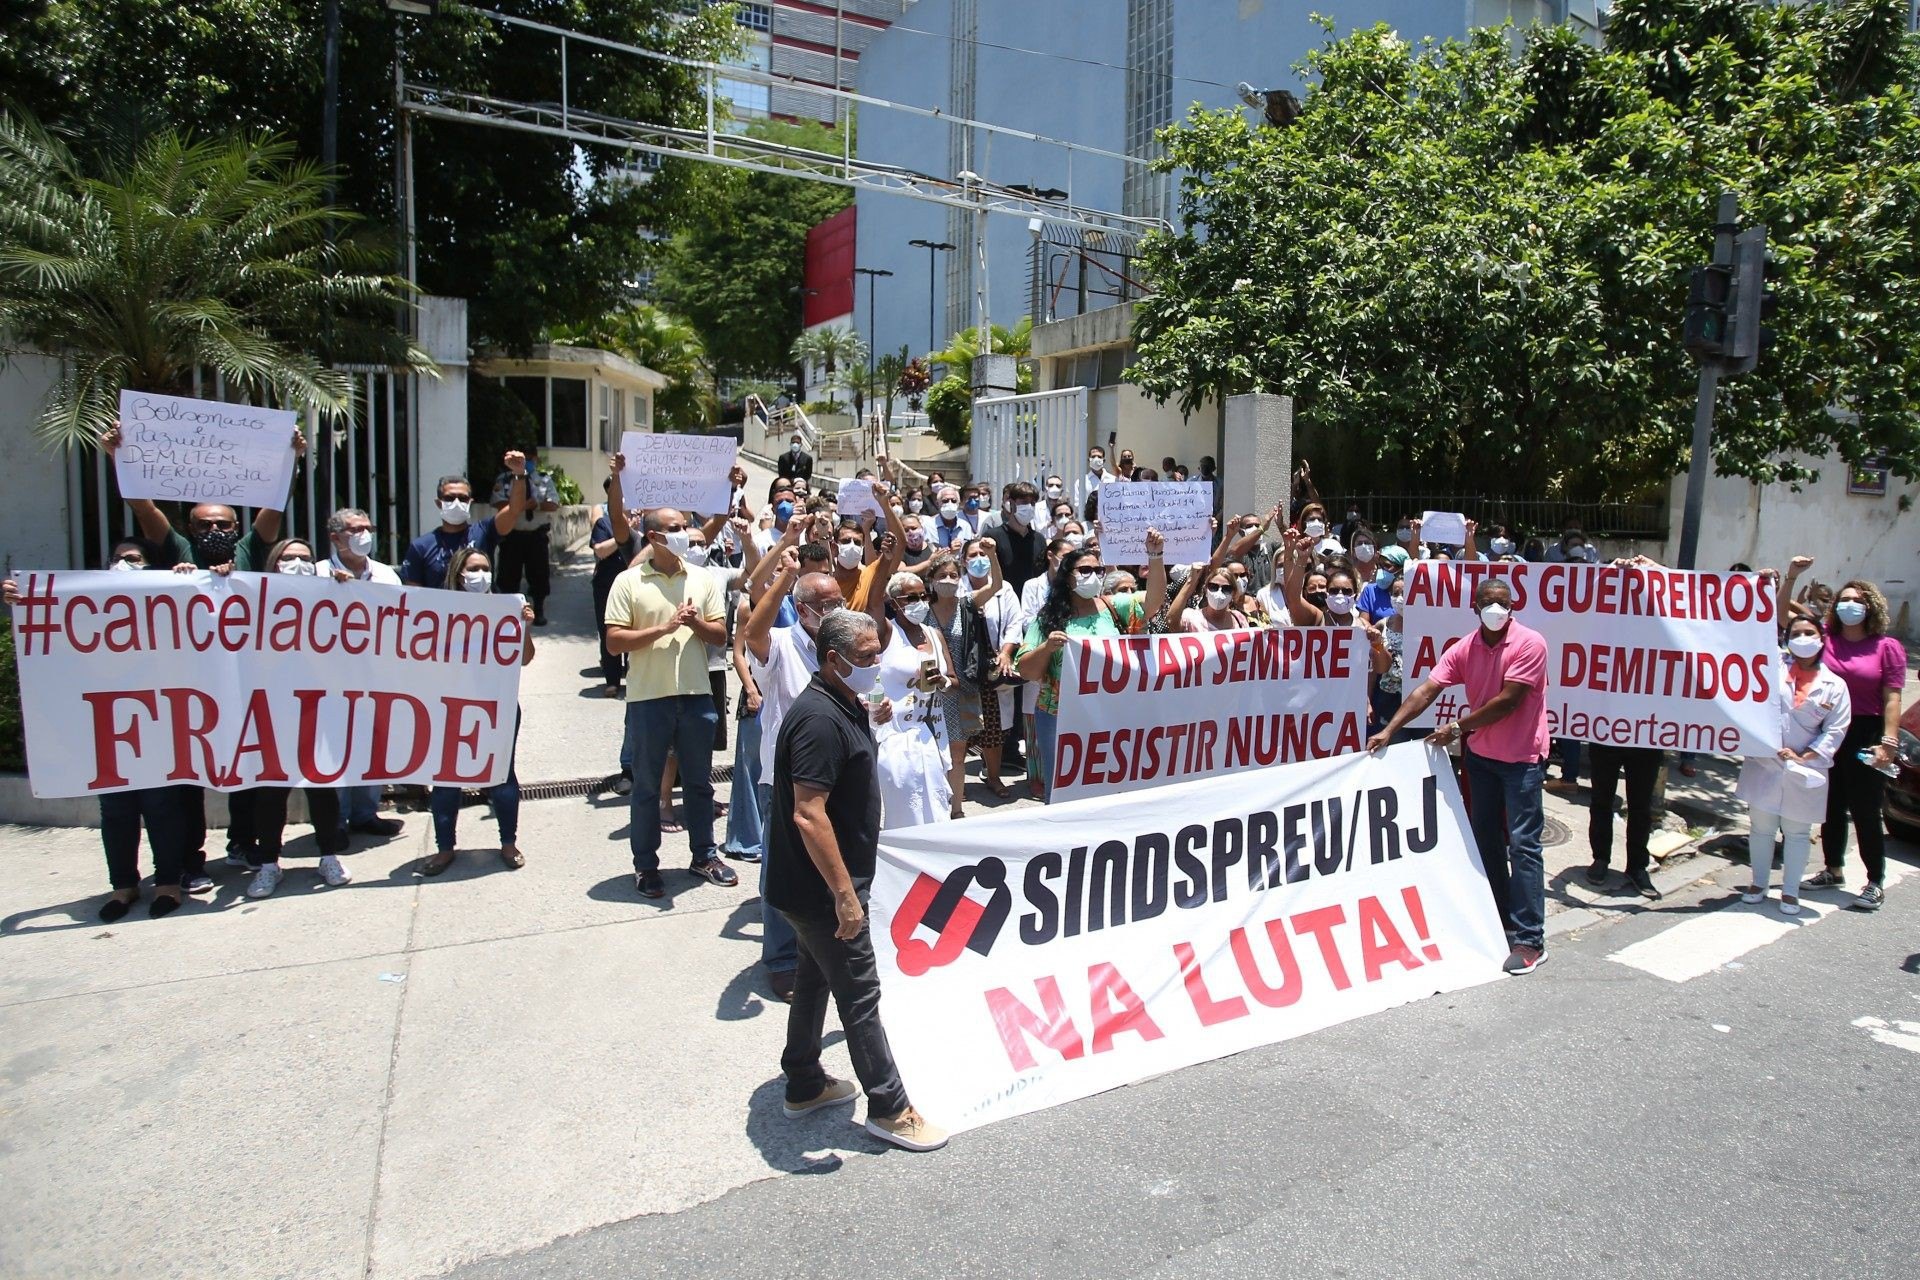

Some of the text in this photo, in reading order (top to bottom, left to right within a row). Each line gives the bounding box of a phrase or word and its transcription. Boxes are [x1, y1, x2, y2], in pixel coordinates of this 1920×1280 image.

[130, 422, 239, 451] Pazuello
[131, 397, 265, 430] Bolsonaro
[194, 425, 204, 435] e
[236, 468, 271, 481] da
[684, 455, 703, 465] NO
[156, 478, 246, 498] SAÚDE
[635, 479, 697, 494] FRAUDE NO
[1405, 563, 1774, 623] ANTS GUERREIROS
[17, 573, 521, 667] #cancelacertame
[1078, 636, 1206, 695] LUTAR
[1212, 629, 1353, 685] SEMPRE
[1560, 643, 1770, 702] DEMITIDOS
[82, 687, 498, 790] FRAUDE
[1052, 711, 1362, 789] DESISTIR NUNCA
[984, 885, 1443, 1073] NA LUTA!
